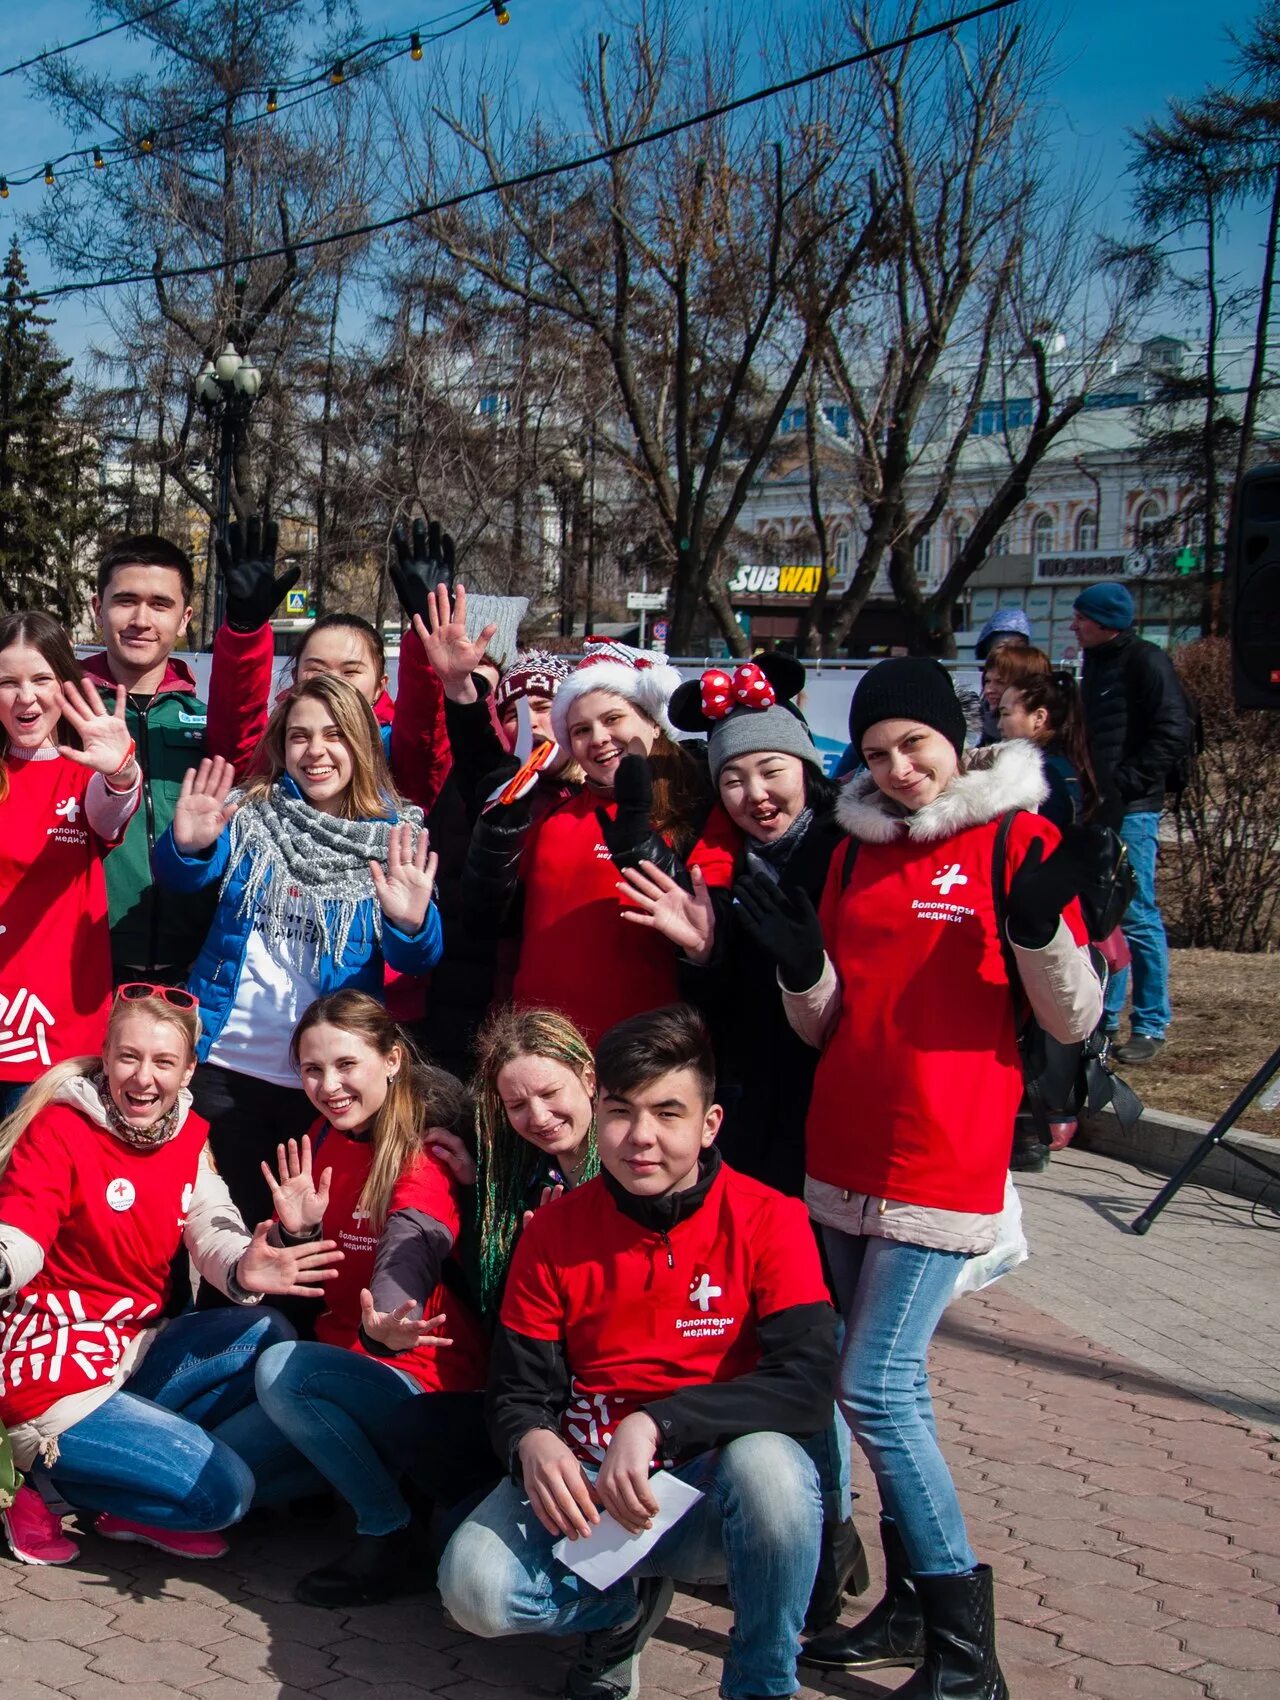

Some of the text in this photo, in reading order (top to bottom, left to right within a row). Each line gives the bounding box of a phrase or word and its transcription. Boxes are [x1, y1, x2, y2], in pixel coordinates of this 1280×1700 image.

[911, 900, 974, 915] Волонтеры
[917, 911, 961, 923] медики
[676, 1317, 734, 1328] Волонтеры
[683, 1328, 724, 1337] медики
